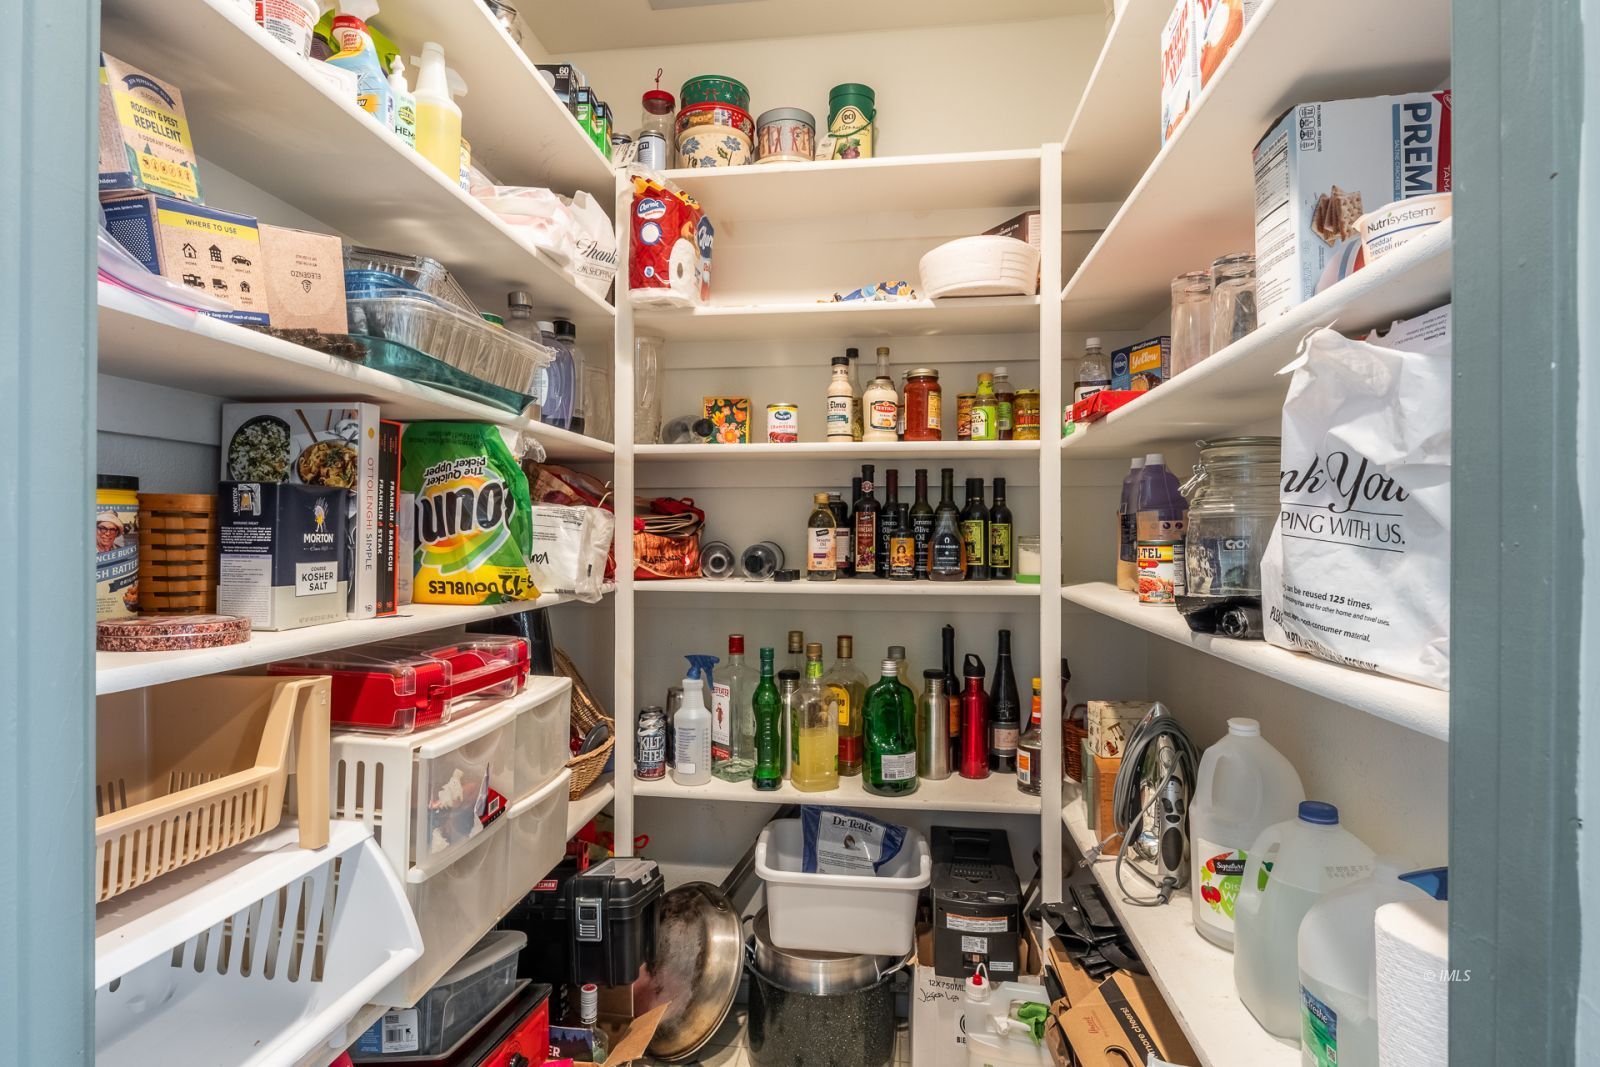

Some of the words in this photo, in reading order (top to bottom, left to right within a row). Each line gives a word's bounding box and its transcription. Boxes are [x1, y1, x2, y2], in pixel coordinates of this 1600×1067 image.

[559, 67, 569, 75] 60
[130, 101, 157, 119] RODENT
[158, 113, 164, 122] &
[164, 115, 178, 128] PEST
[133, 114, 182, 142] REPELLENT
[185, 218, 211, 230] WHERE
[213, 223, 223, 232] TO
[224, 227, 238, 235] USE
[1367, 206, 1437, 234] Nutrisystem
[1132, 351, 1158, 370] Yellow
[423, 460, 453, 478] Upper
[454, 456, 487, 471] Picker
[464, 466, 484, 478] The
[425, 469, 463, 487] Quicker
[1326, 451, 1410, 514] You
[366, 457, 374, 531] OTTOLENGHI
[303, 533, 334, 544] MORTON
[376, 525, 384, 555] STEAK
[1330, 516, 1371, 541] WITH
[1376, 522, 1406, 546] US.
[96, 550, 117, 563] NCLE
[365, 533, 373, 571] SIMPLE
[96, 569, 110, 580] SH
[302, 571, 334, 582] KOSHER
[309, 581, 328, 592] SALT
[428, 579, 498, 597] DOUBLES
[1293, 585, 1302, 596] be
[1302, 589, 1328, 602] reused
[1329, 594, 1345, 605] 125
[1346, 598, 1373, 611] times.
[1335, 608, 1352, 618] home
[640, 736, 661, 750] KILT
[832, 815, 847, 827] Dr
[1216, 861, 1244, 871] Signature
[928, 979, 966, 992] 12X750ML
[1119, 1006, 1142, 1033] cheers!
[1138, 1032, 1155, 1054] more
